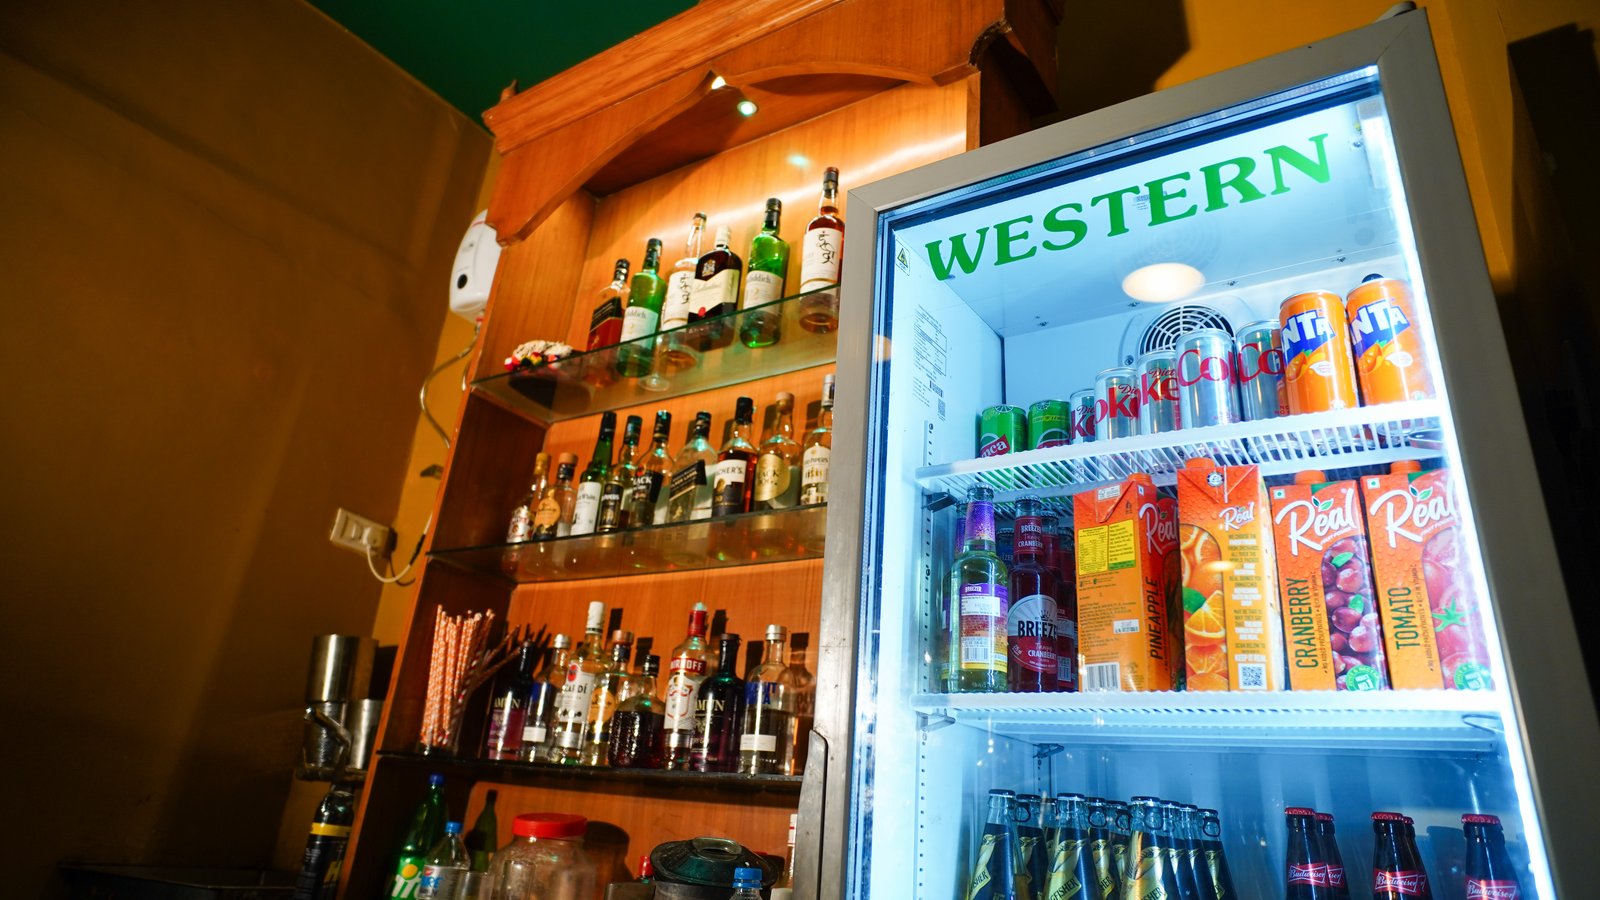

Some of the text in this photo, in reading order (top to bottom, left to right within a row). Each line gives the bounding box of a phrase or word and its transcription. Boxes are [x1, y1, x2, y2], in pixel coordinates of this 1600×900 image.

[925, 133, 1332, 282] WESTERN
[1282, 311, 1335, 353] NTA
[1350, 299, 1409, 346] NTA
[1138, 502, 1179, 555] Real
[1218, 501, 1255, 532] Real
[1275, 487, 1358, 556] Real
[1370, 481, 1457, 549] Real
[1145, 576, 1164, 661] PINEAPPLE
[1285, 577, 1319, 669] CRANBERRY
[1387, 586, 1421, 651] TOMATO
[1290, 868, 1326, 879] Budweiser
[1376, 874, 1417, 886] Budweiser
[1466, 883, 1513, 898] Budweiser
